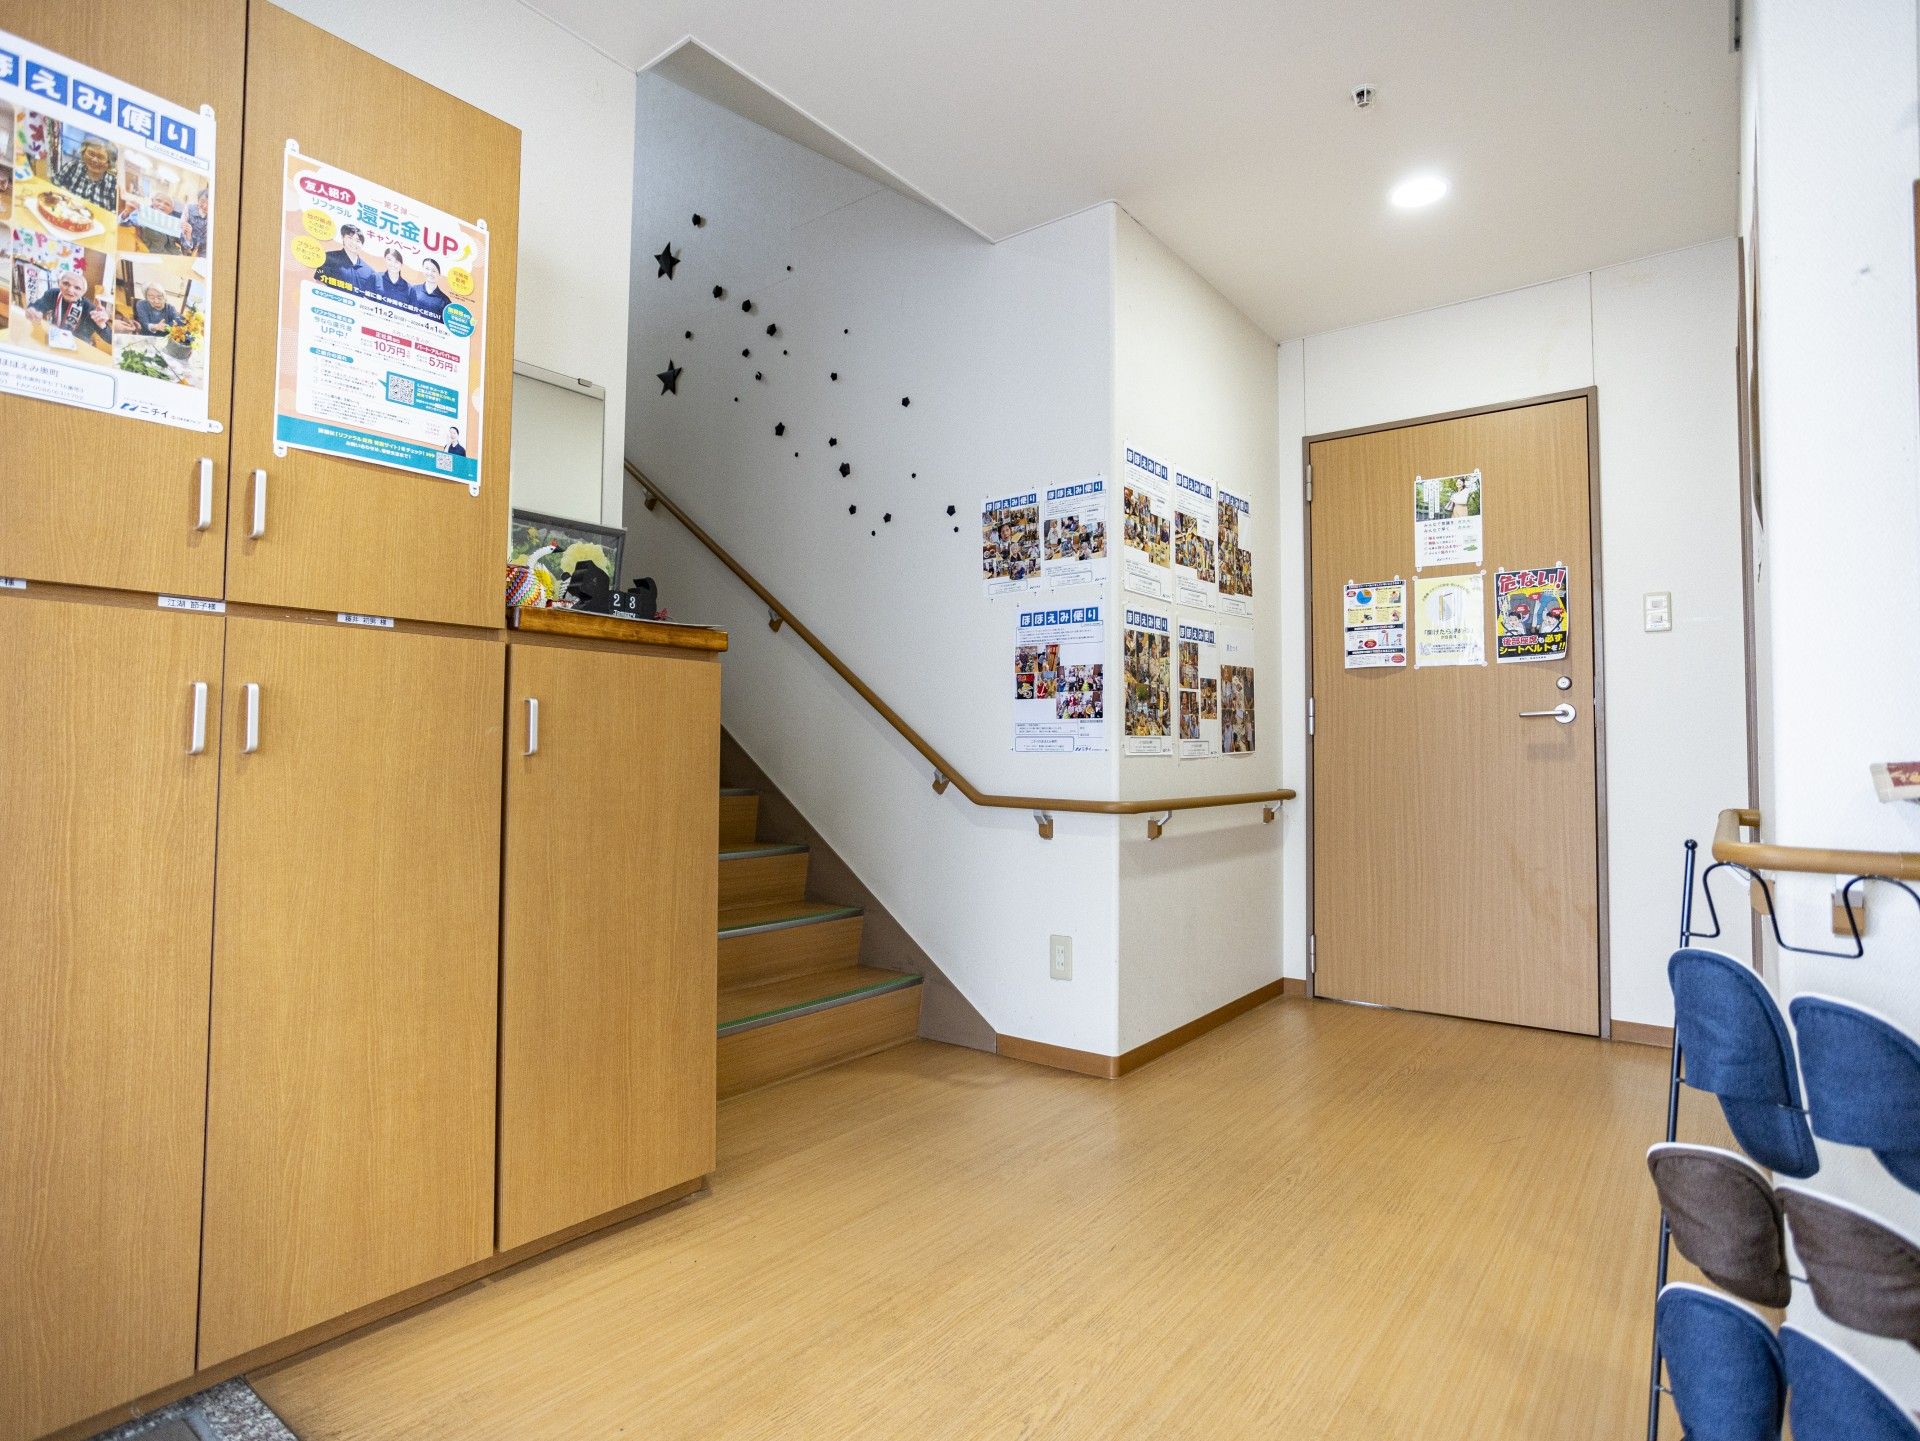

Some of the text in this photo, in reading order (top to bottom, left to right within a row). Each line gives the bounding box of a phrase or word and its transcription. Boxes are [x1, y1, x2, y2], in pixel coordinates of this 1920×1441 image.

[304, 180, 351, 202] 友人紹介
[312, 197, 352, 217] リファラル
[366, 229, 421, 255] キャンペーン
[374, 341, 406, 358] 10万円
[428, 356, 454, 373] 5万円
[141, 405, 169, 418] ニチイ
[1499, 569, 1565, 594] 危ない!
[1021, 607, 1098, 627] ほほえみ便り
[1499, 641, 1565, 655] シートベルトを!!
